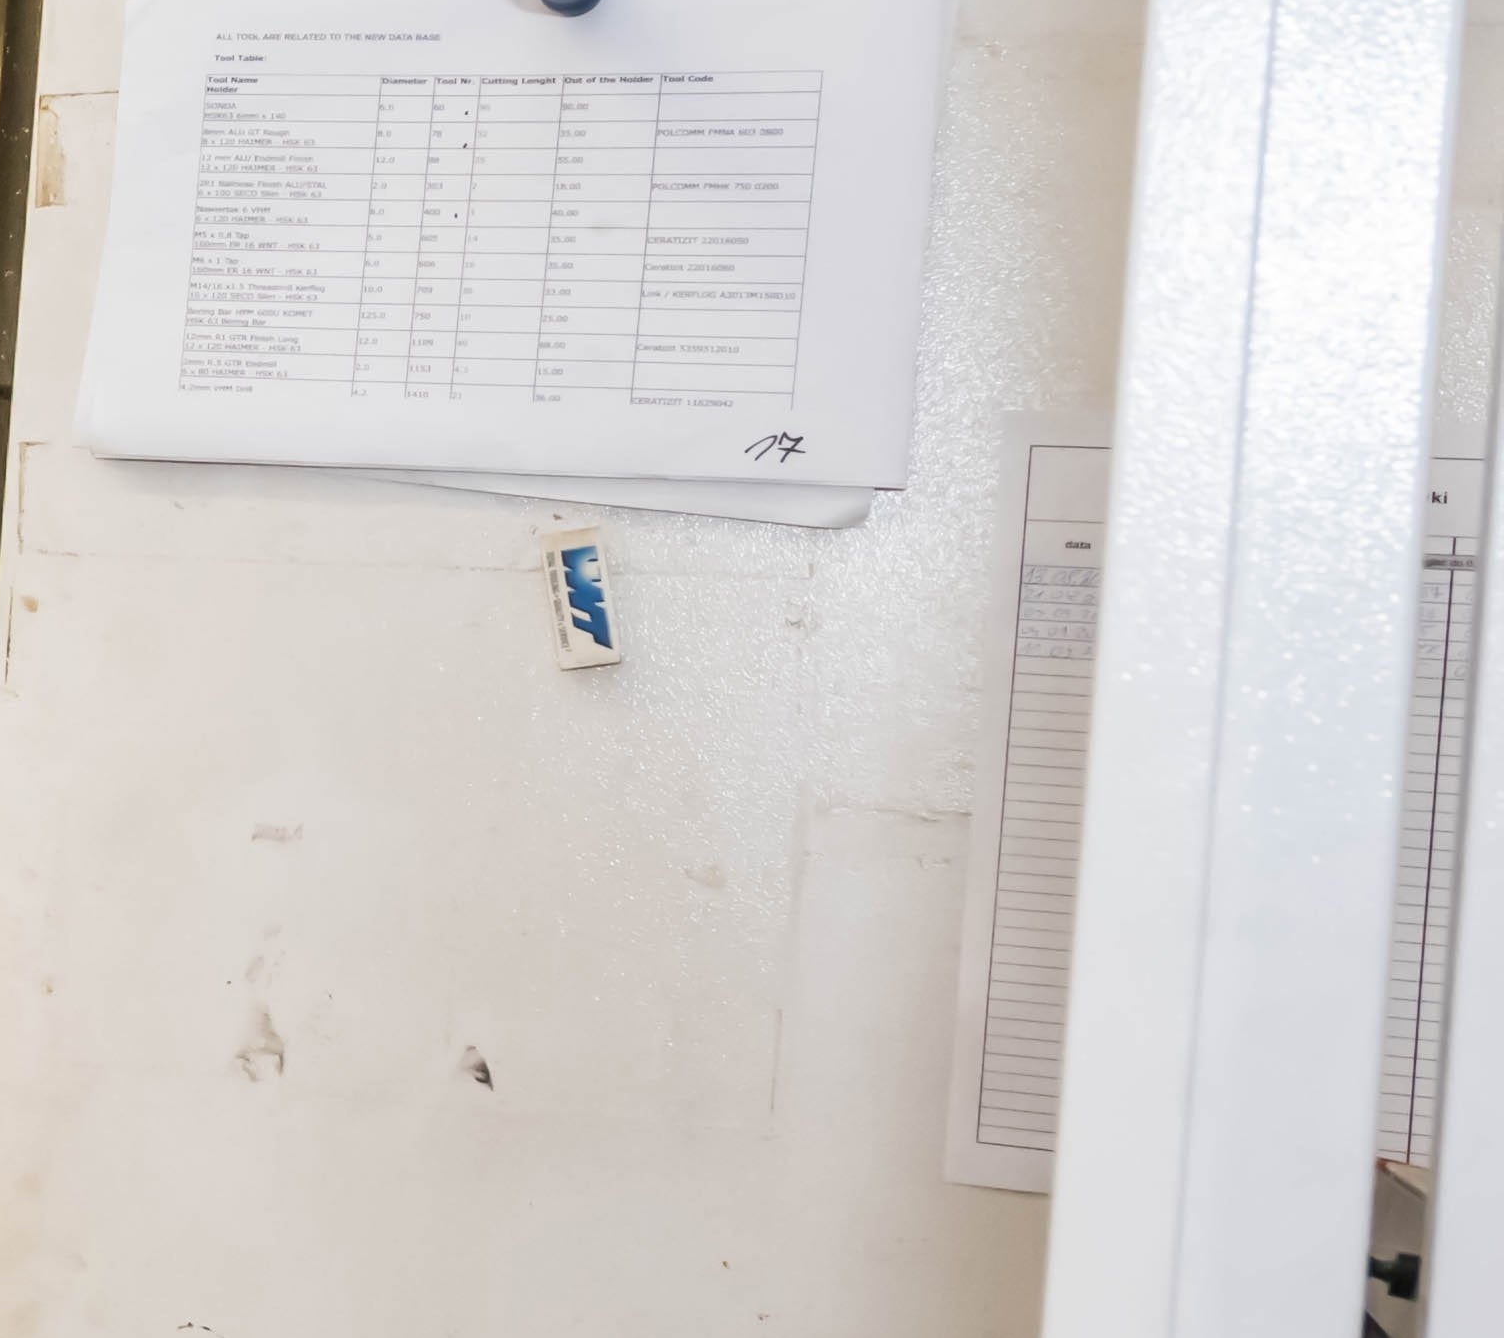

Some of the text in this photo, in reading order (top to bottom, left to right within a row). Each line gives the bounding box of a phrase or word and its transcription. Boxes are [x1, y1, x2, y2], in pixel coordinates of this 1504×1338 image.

[482, 77, 555, 86] Cutting Lenght
[564, 76, 654, 84] Out of the Holder
[664, 75, 713, 83] Tool Code
